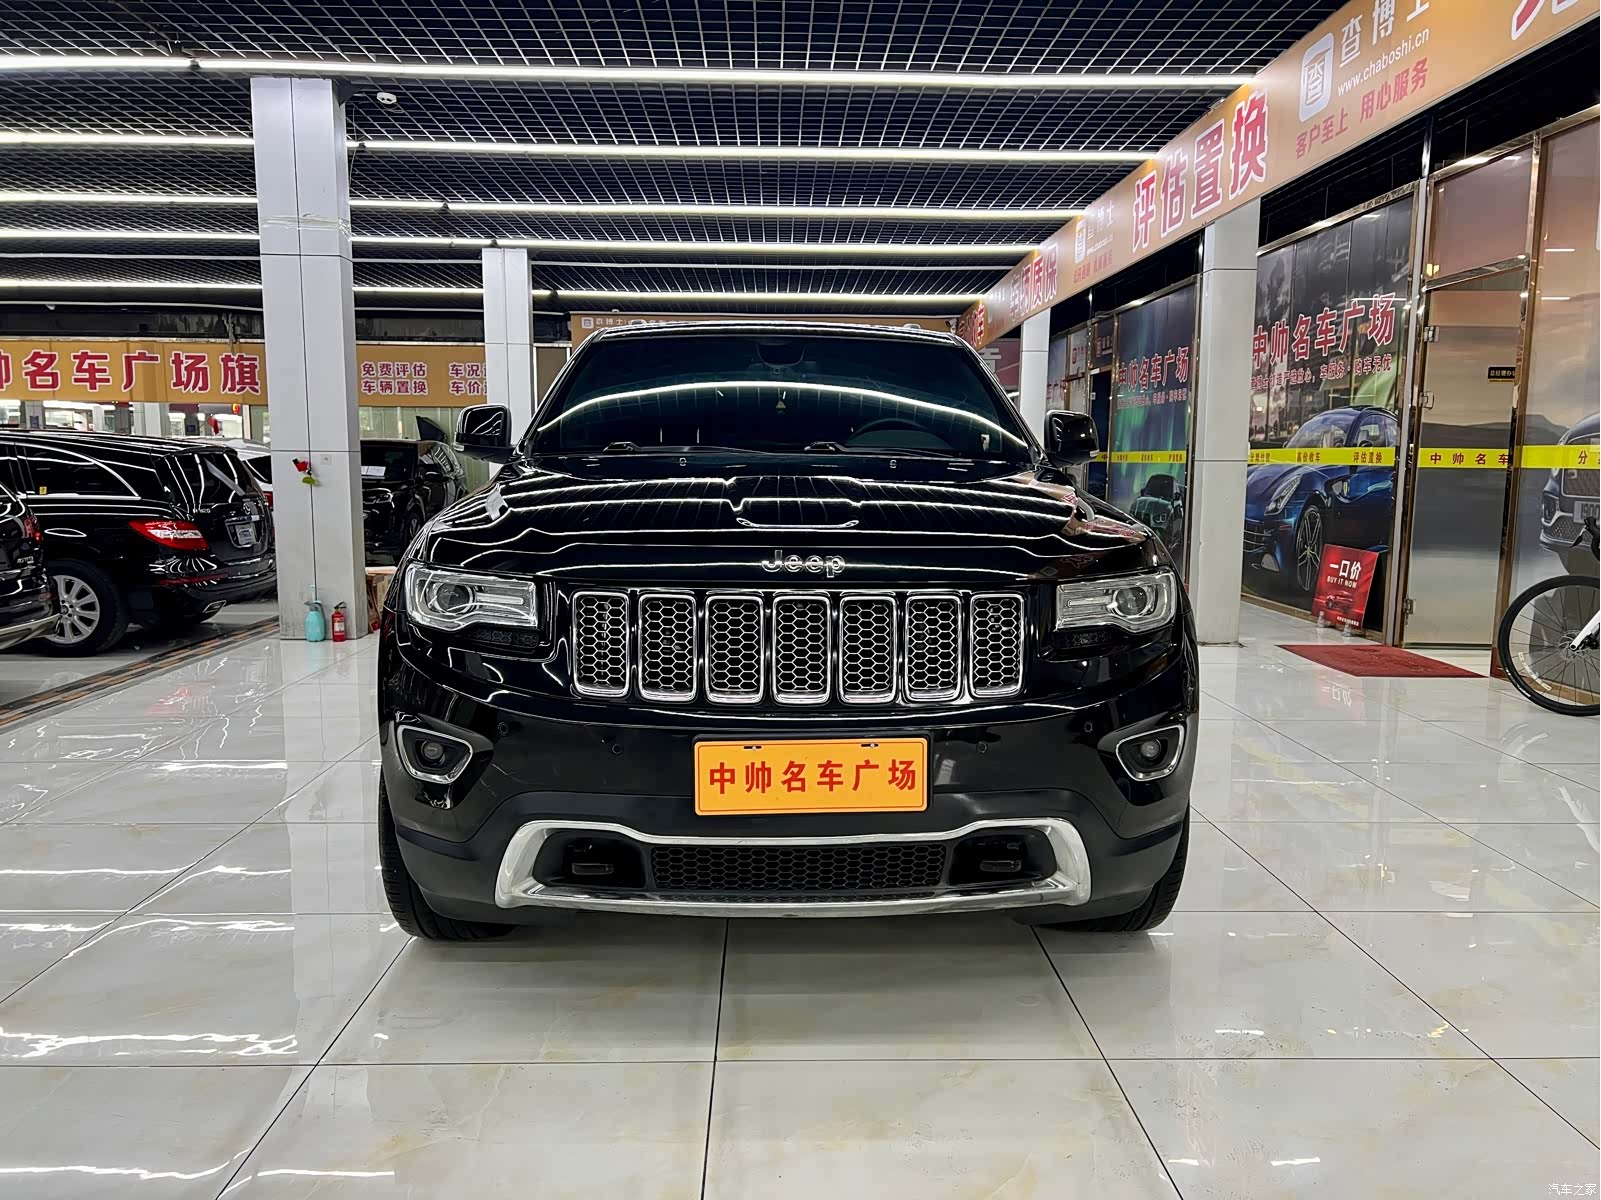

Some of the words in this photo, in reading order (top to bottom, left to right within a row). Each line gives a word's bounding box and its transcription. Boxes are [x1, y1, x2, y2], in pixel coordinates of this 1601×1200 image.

[1337, 28, 1429, 97] www.chaboshi.cn
[1296, 107, 1348, 160] 客户至上
[1359, 57, 1428, 123] 用心服务
[1132, 87, 1269, 254] 评估置换
[1252, 292, 1396, 370] 中帅名车广场
[361, 361, 428, 378] 免费评估
[448, 362, 486, 378] 车况
[1117, 346, 1190, 394] 中帅名车广场
[361, 379, 428, 395] 车辆置换
[448, 380, 487, 395] 车价
[1296, 451, 1321, 464] 高价收车
[1353, 451, 1383, 465] 评估置换
[761, 549, 846, 578] Jeep
[1329, 559, 1362, 580] 一口价
[1326, 575, 1338, 584] BUY
[1344, 580, 1358, 589] NOW
[709, 758, 917, 795] 中帅名车广场
